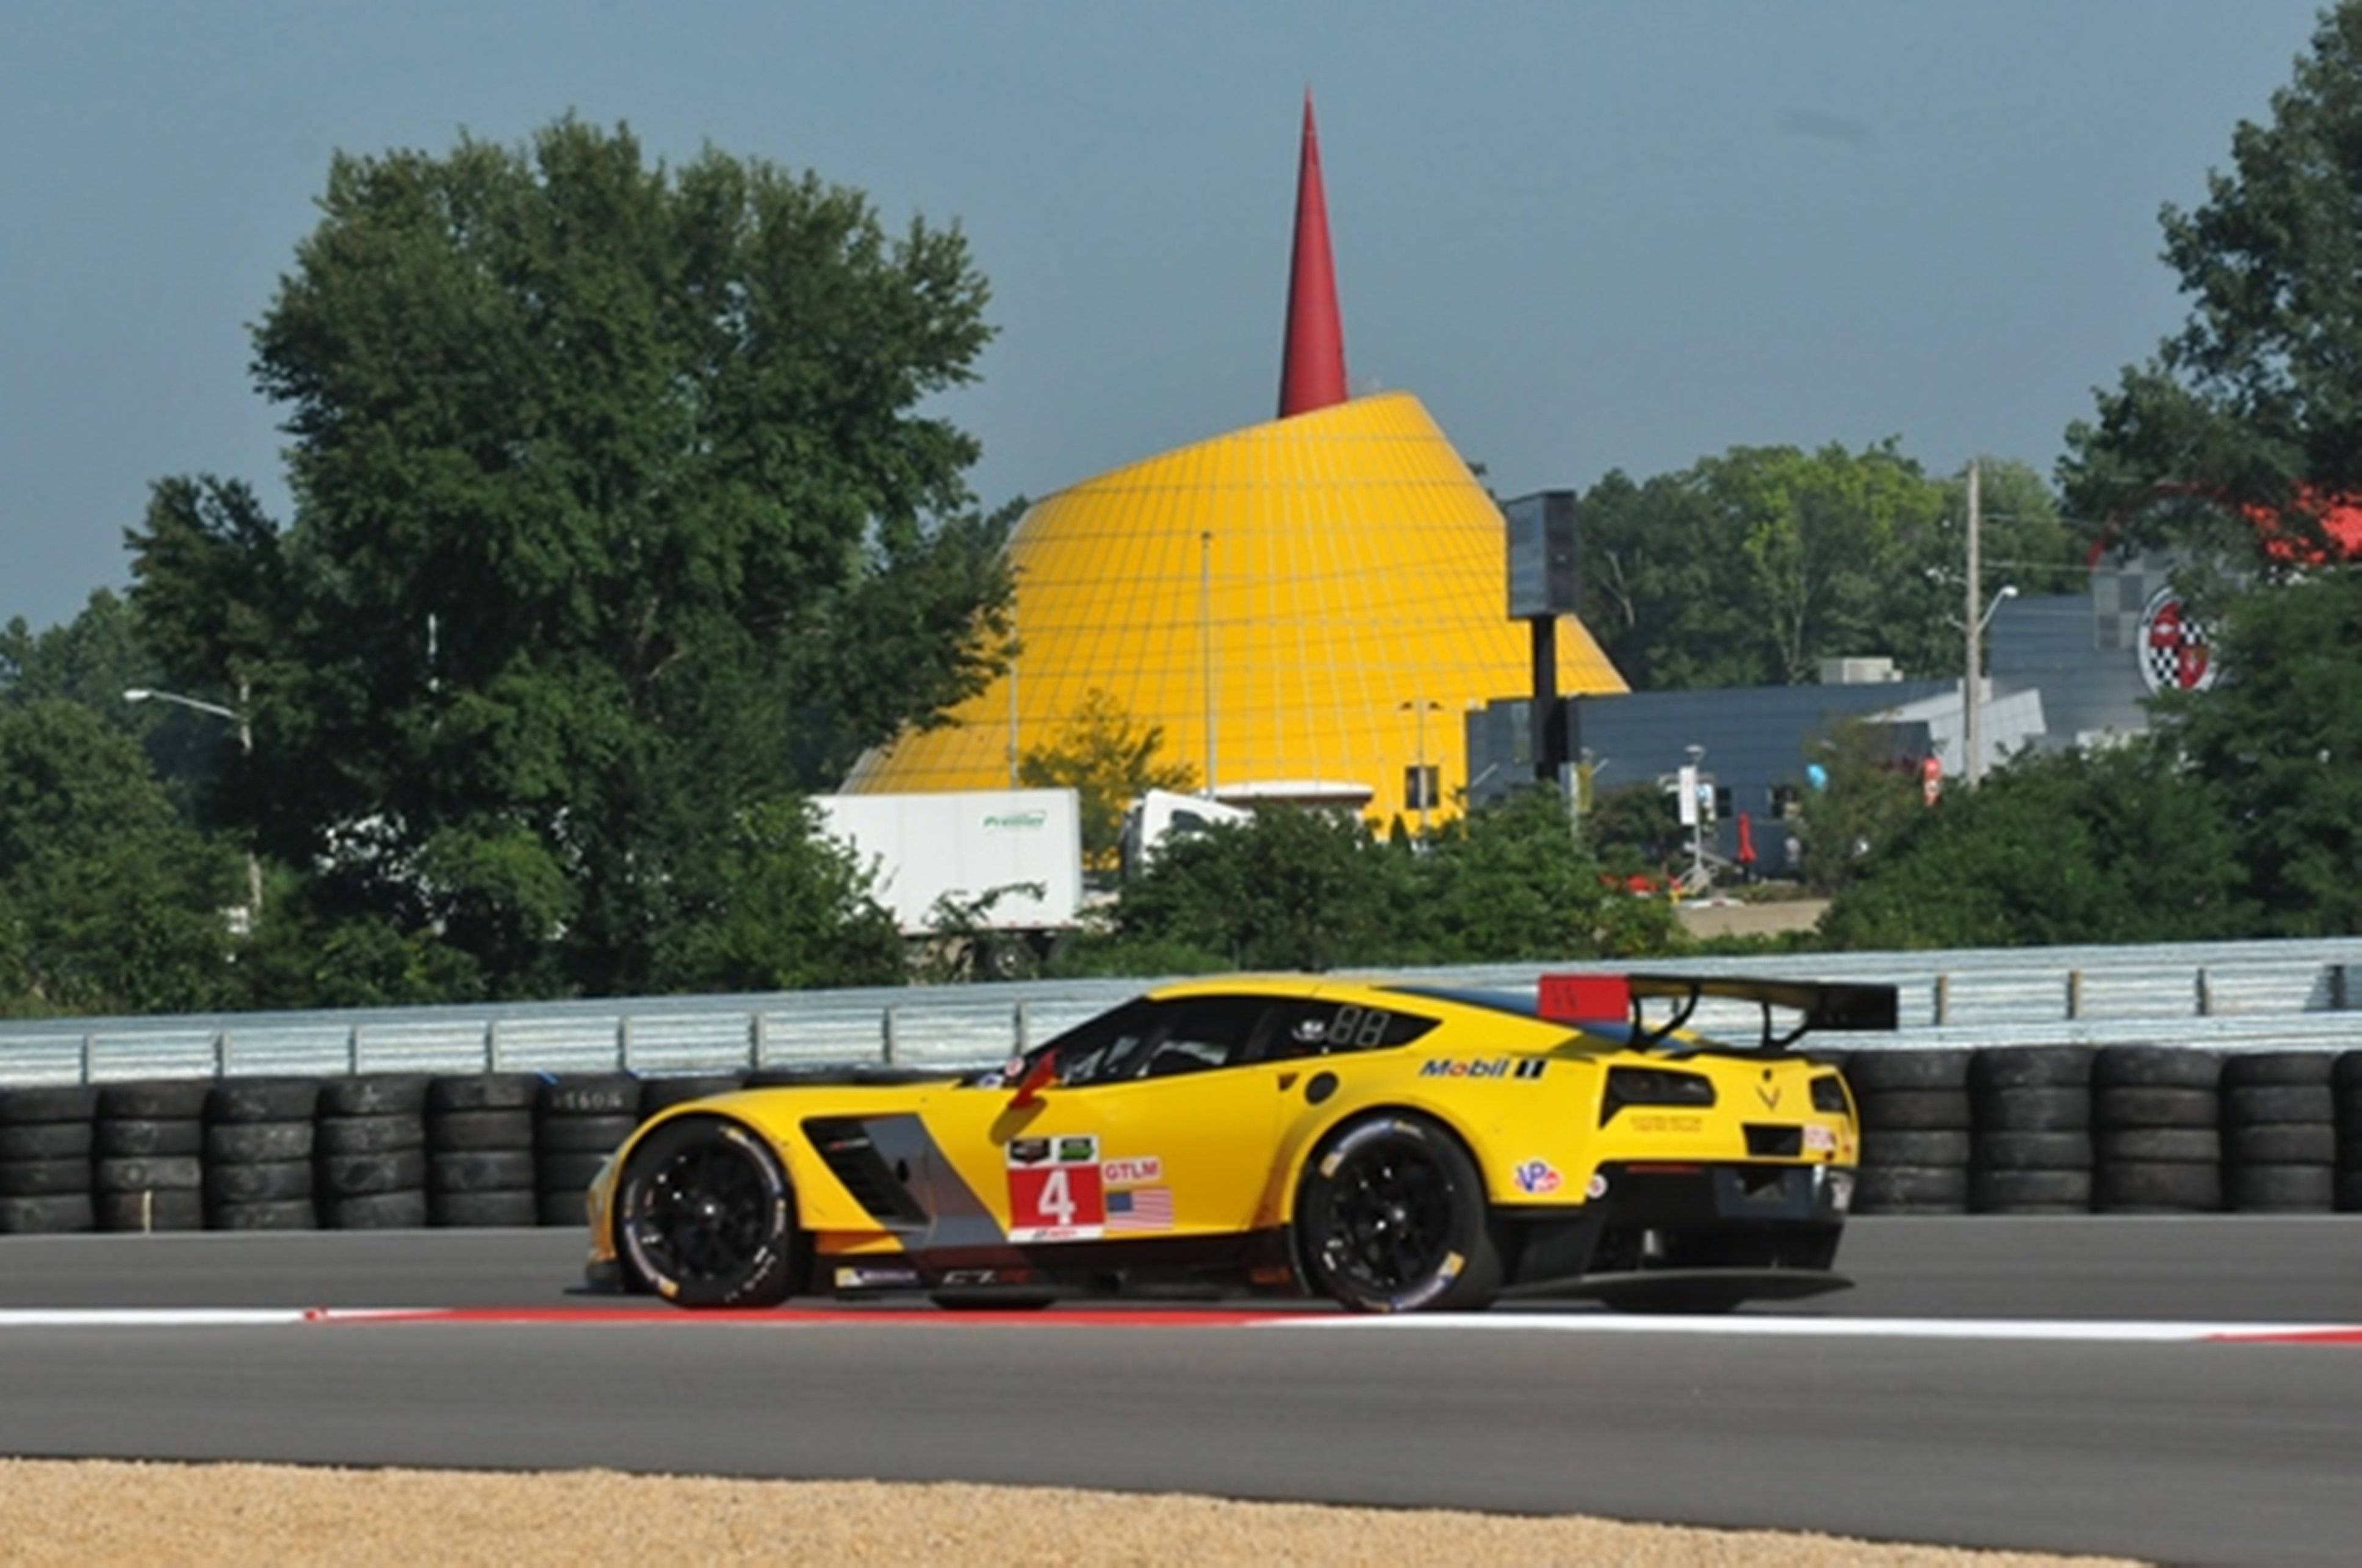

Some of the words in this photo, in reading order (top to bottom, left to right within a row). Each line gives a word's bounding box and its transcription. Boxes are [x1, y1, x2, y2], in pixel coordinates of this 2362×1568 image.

[1419, 1059, 1510, 1077] Mobil
[1515, 1059, 1546, 1077] 1
[1105, 1162, 1158, 1181] GTLM
[1038, 1170, 1077, 1225] 4
